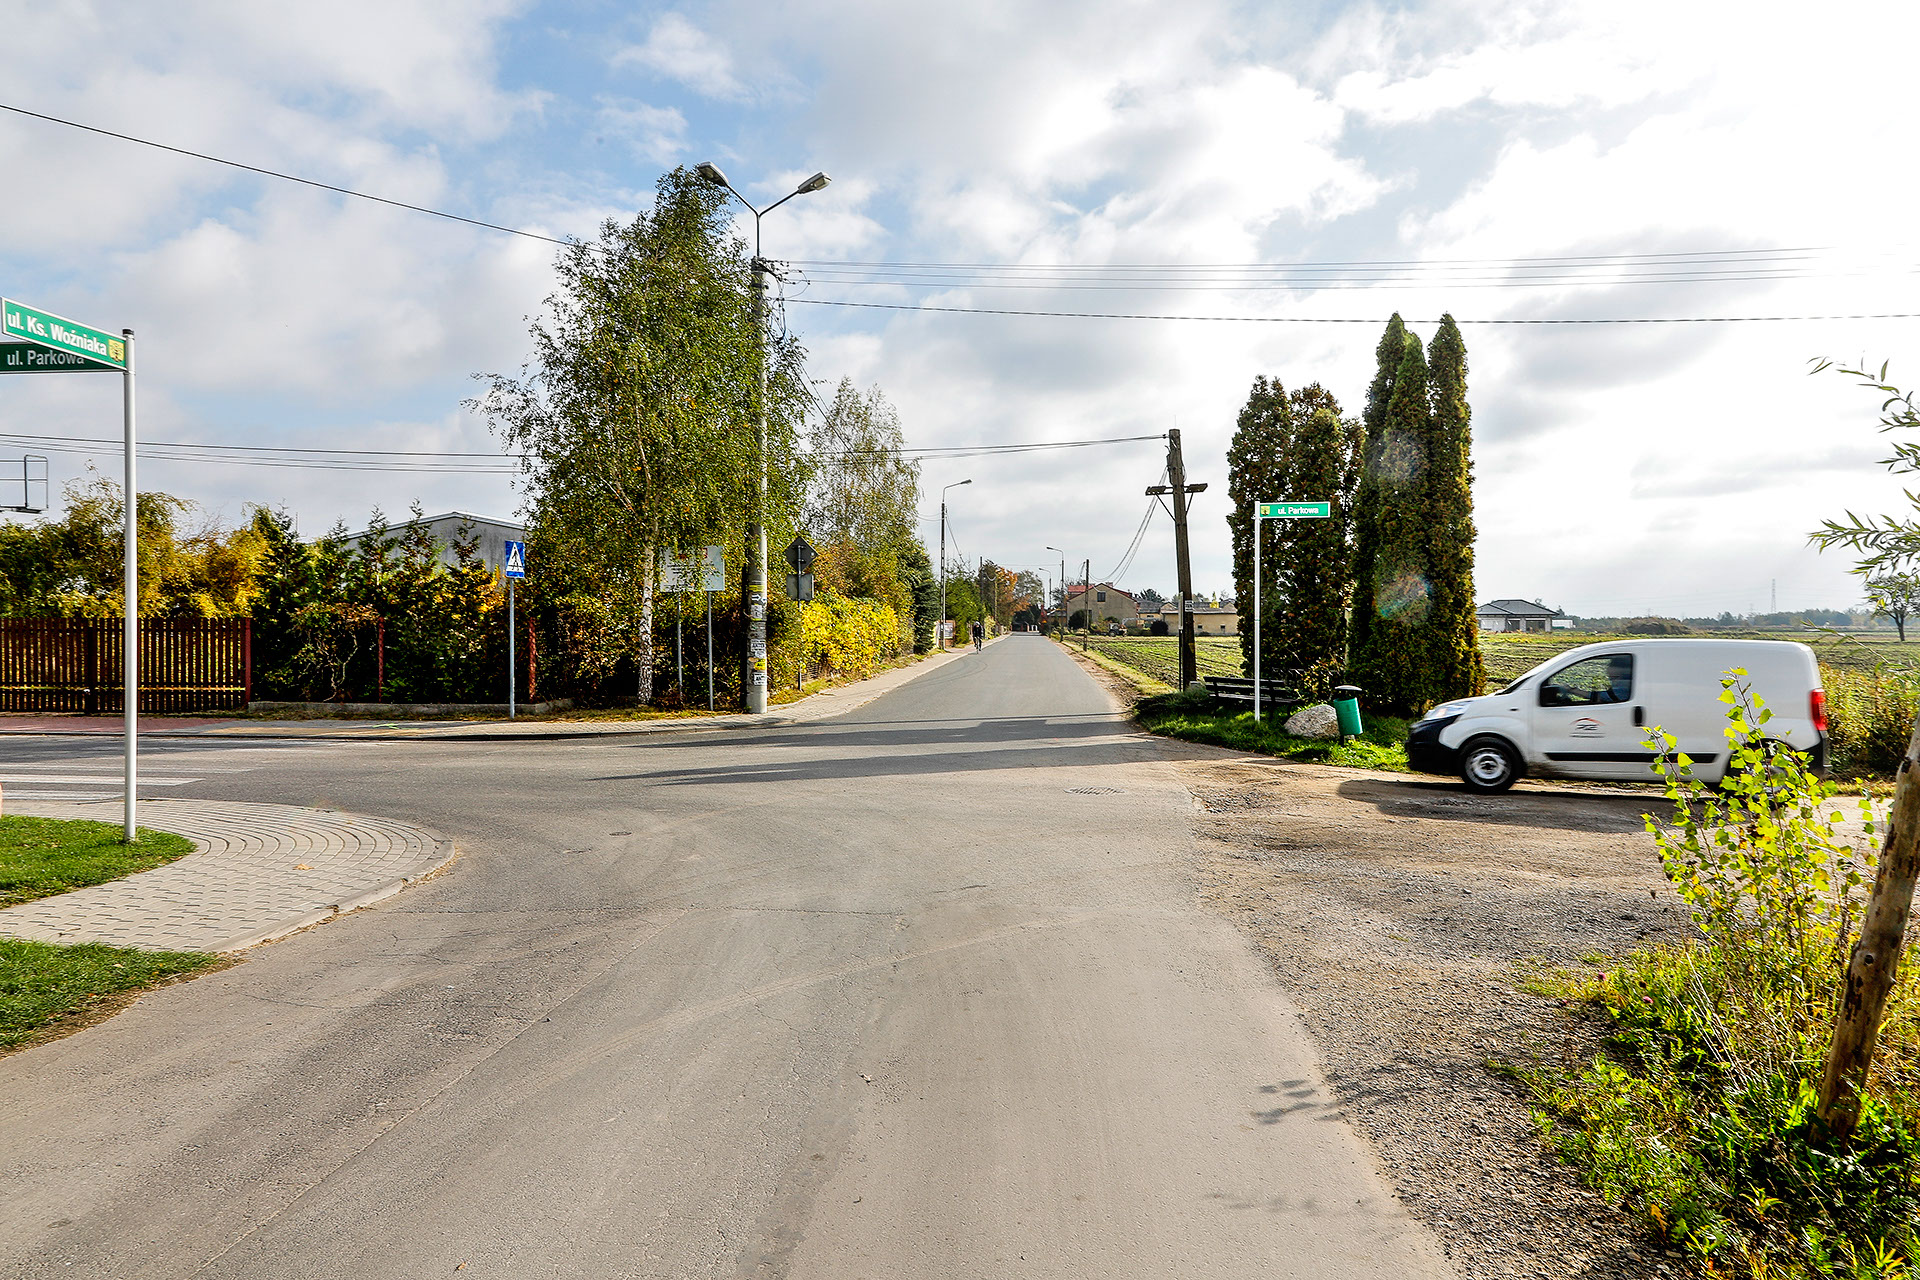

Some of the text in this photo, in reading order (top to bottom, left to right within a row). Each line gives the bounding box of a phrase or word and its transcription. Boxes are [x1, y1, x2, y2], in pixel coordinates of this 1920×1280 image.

[7, 311, 108, 356] ul. Ks. Woźniaka
[7, 350, 85, 366] ul. Parkowa
[1288, 506, 1319, 514] Parkowa
